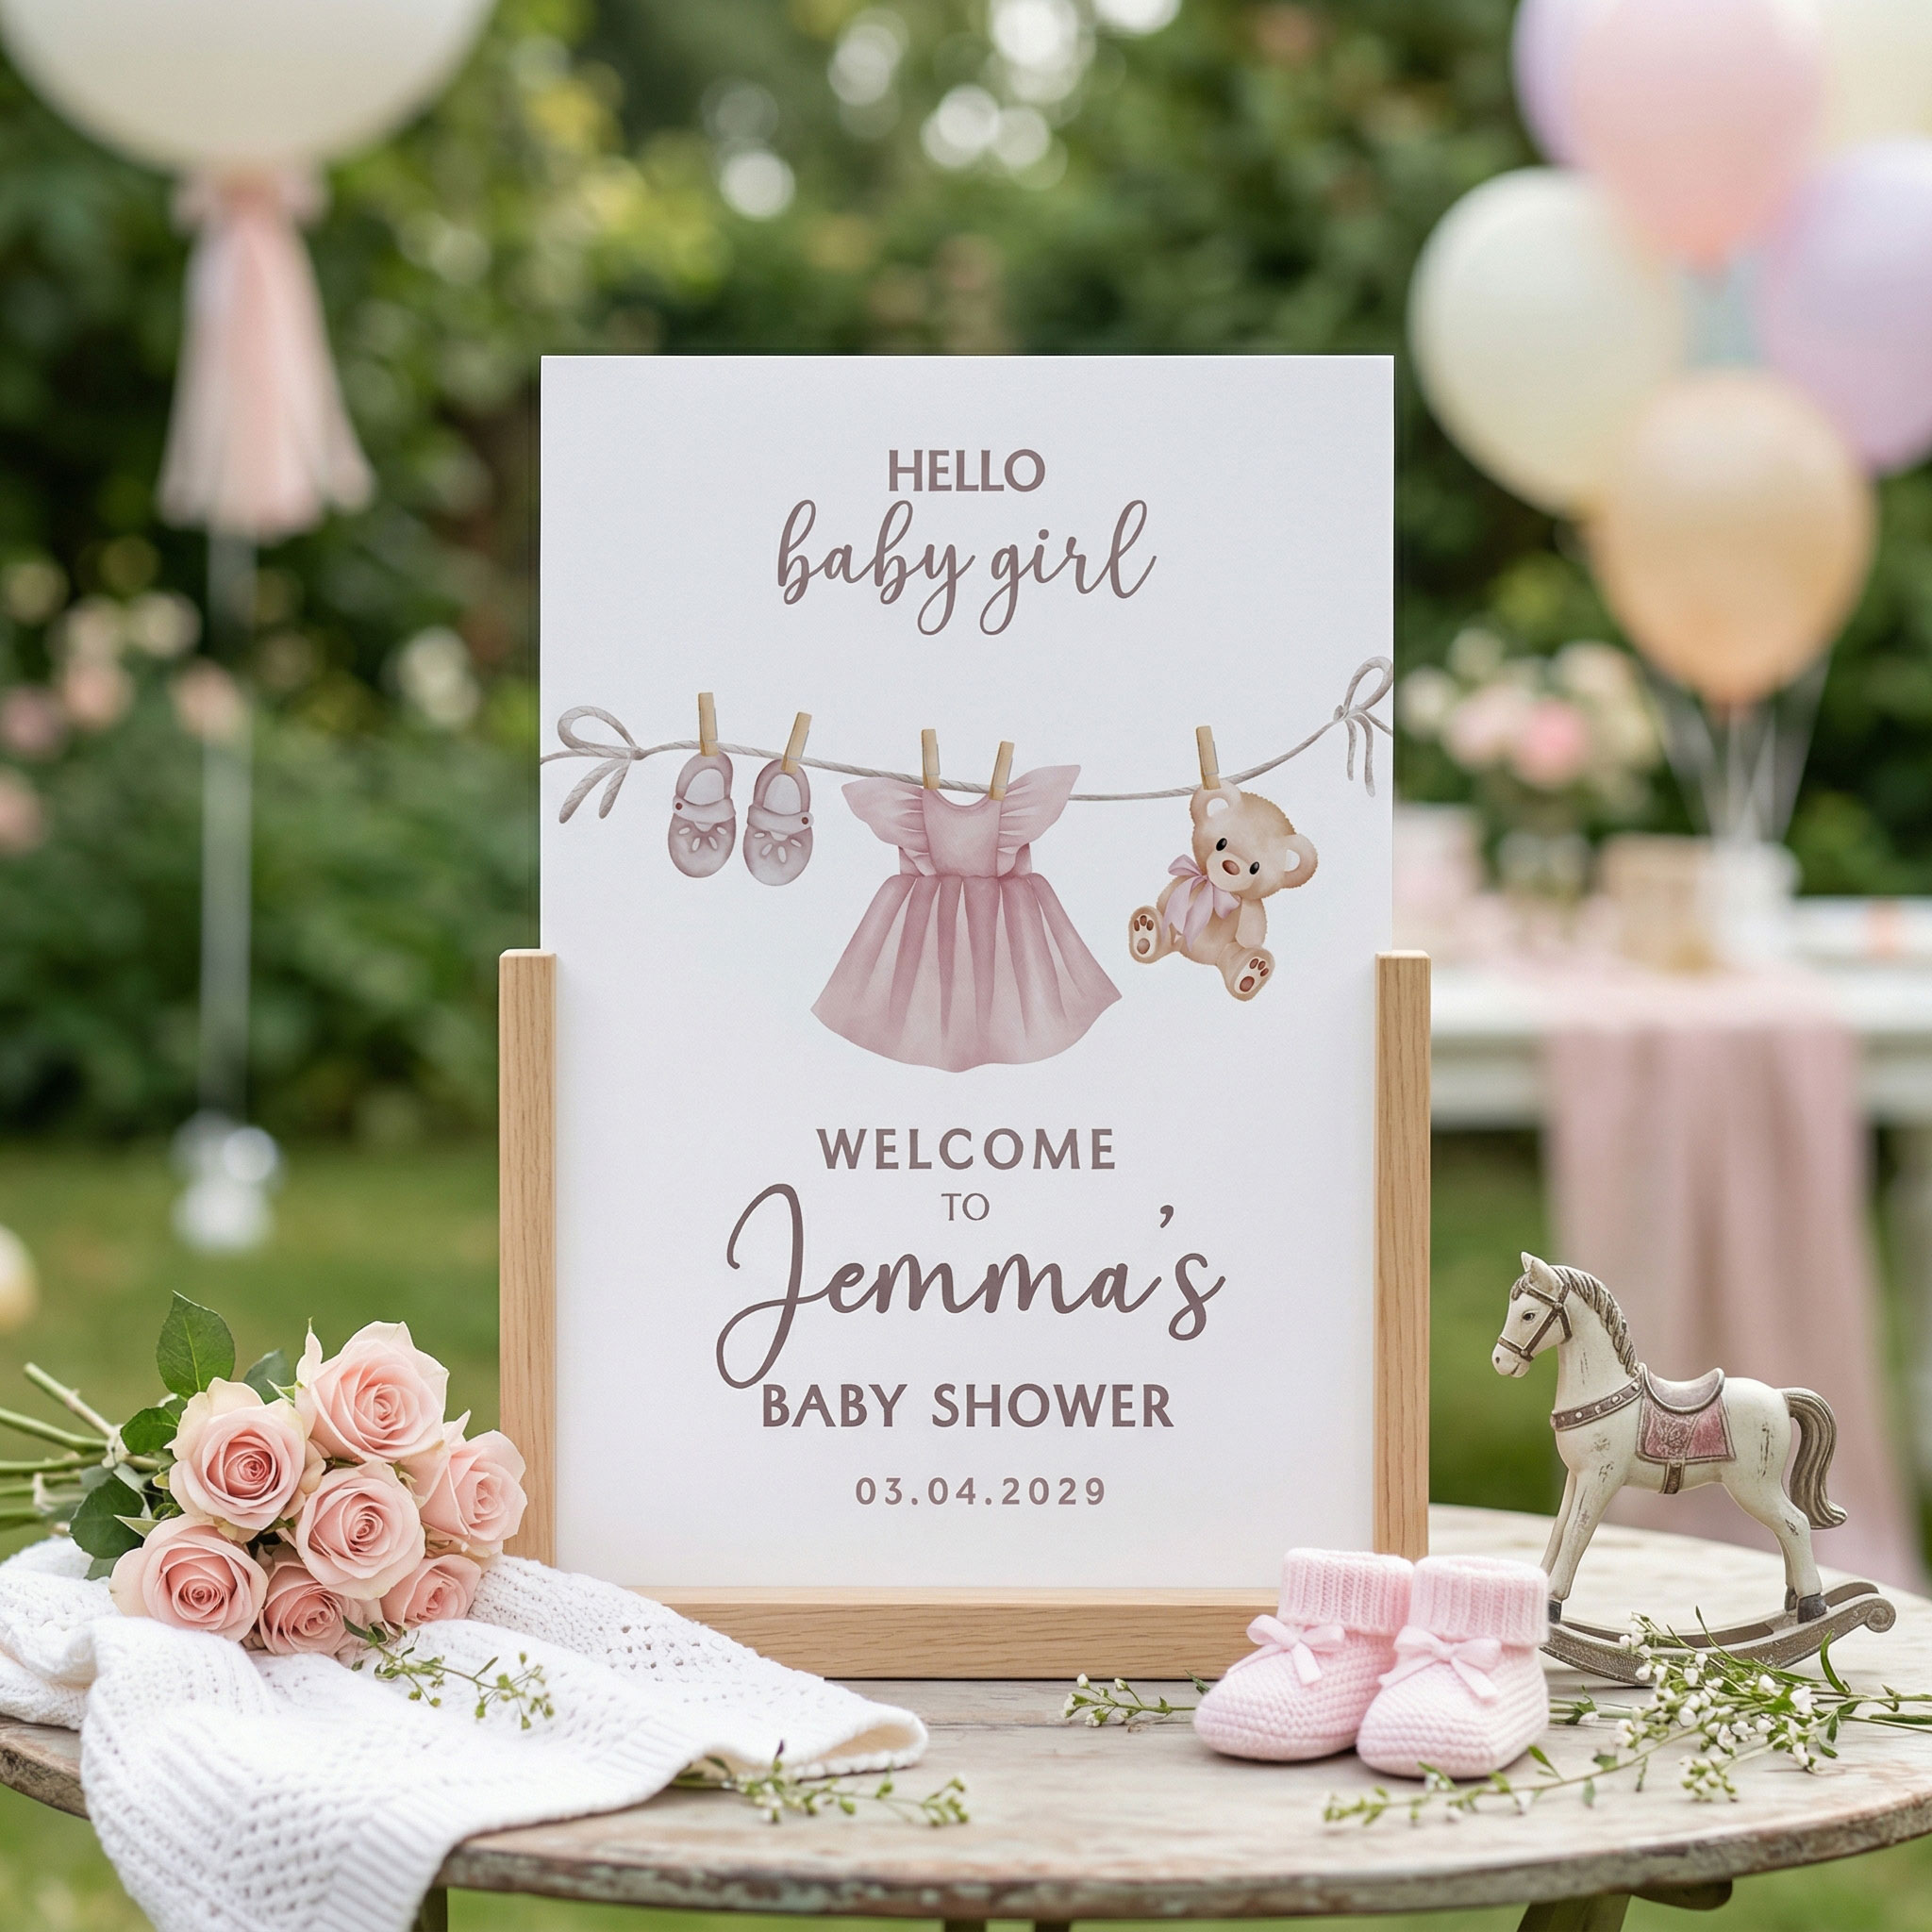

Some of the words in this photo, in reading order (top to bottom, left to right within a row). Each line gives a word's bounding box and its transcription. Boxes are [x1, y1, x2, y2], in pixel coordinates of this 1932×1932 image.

[889, 449, 1046, 492] HELLO
[777, 499, 976, 636] baby
[979, 499, 1158, 636] girl
[816, 1127, 1115, 1171] WELCOME
[941, 1192, 991, 1222] TO
[715, 1183, 1226, 1390] Jemma's
[762, 1383, 908, 1428] BABY
[931, 1383, 1174, 1428] SHOWER
[856, 1476, 1105, 1506] 03.04.2029
